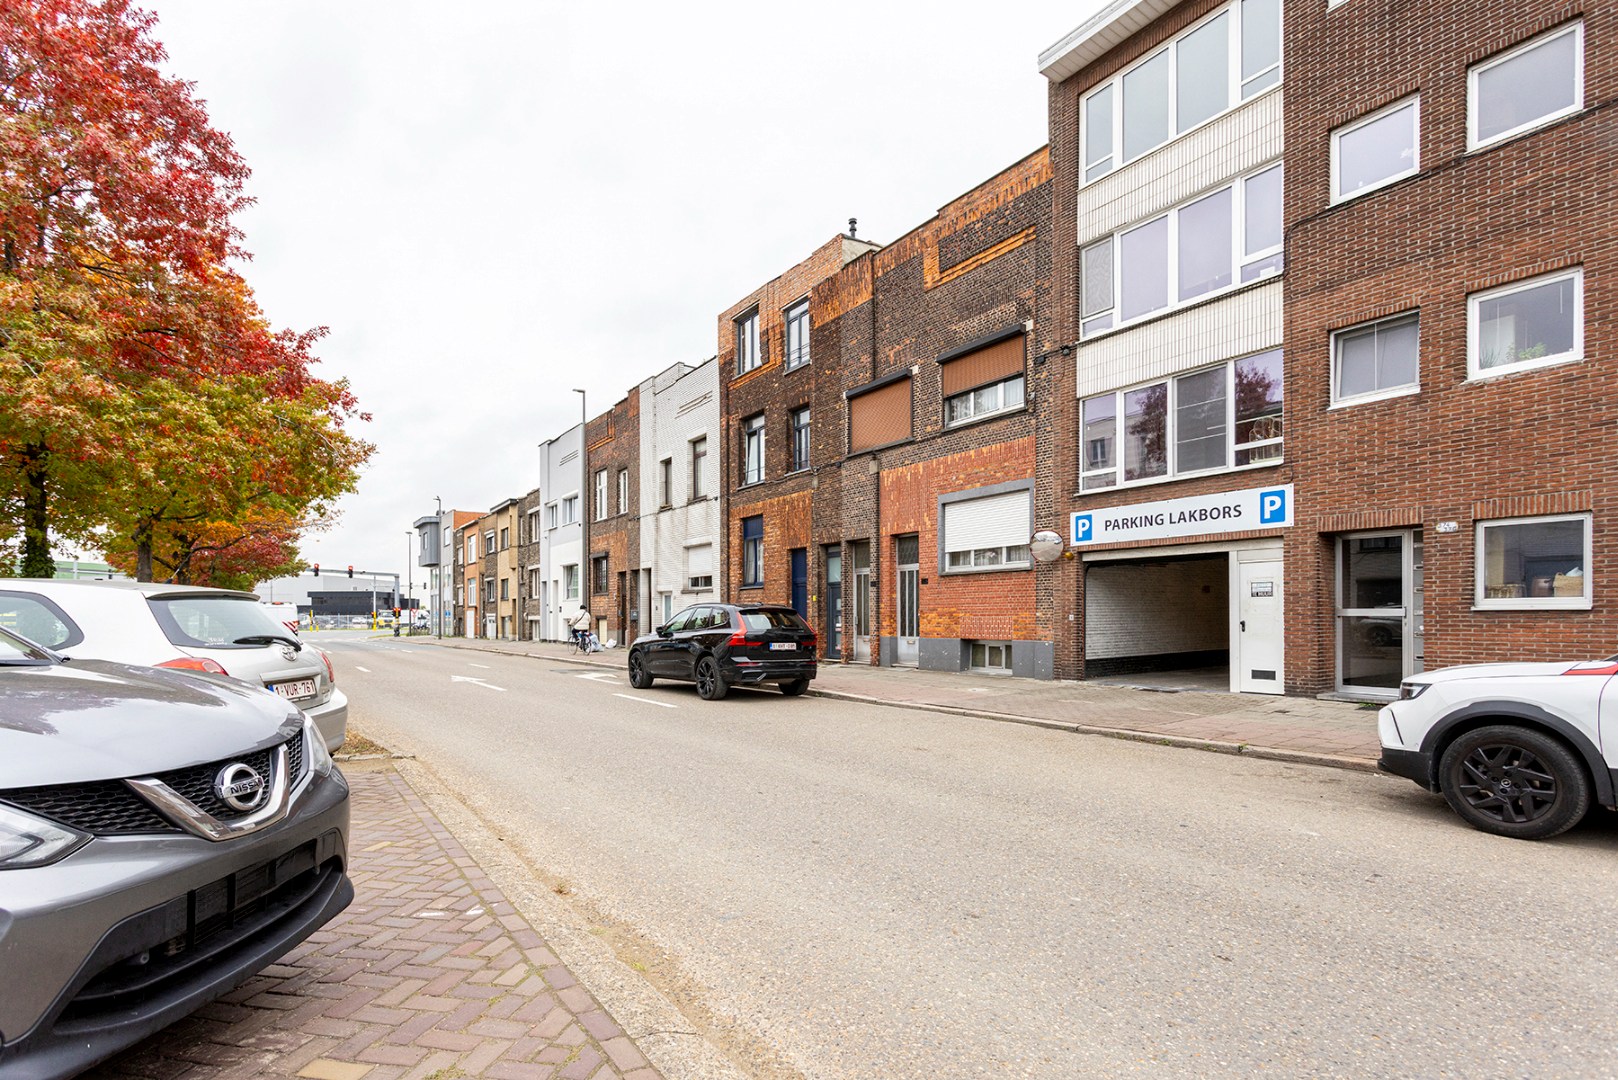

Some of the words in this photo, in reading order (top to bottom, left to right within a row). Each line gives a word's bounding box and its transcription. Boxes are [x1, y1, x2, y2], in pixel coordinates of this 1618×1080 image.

[1077, 518, 1090, 538] P
[1104, 513, 1164, 532] PARKING
[1168, 504, 1242, 525] LAKBORS
[1263, 495, 1282, 519] P
